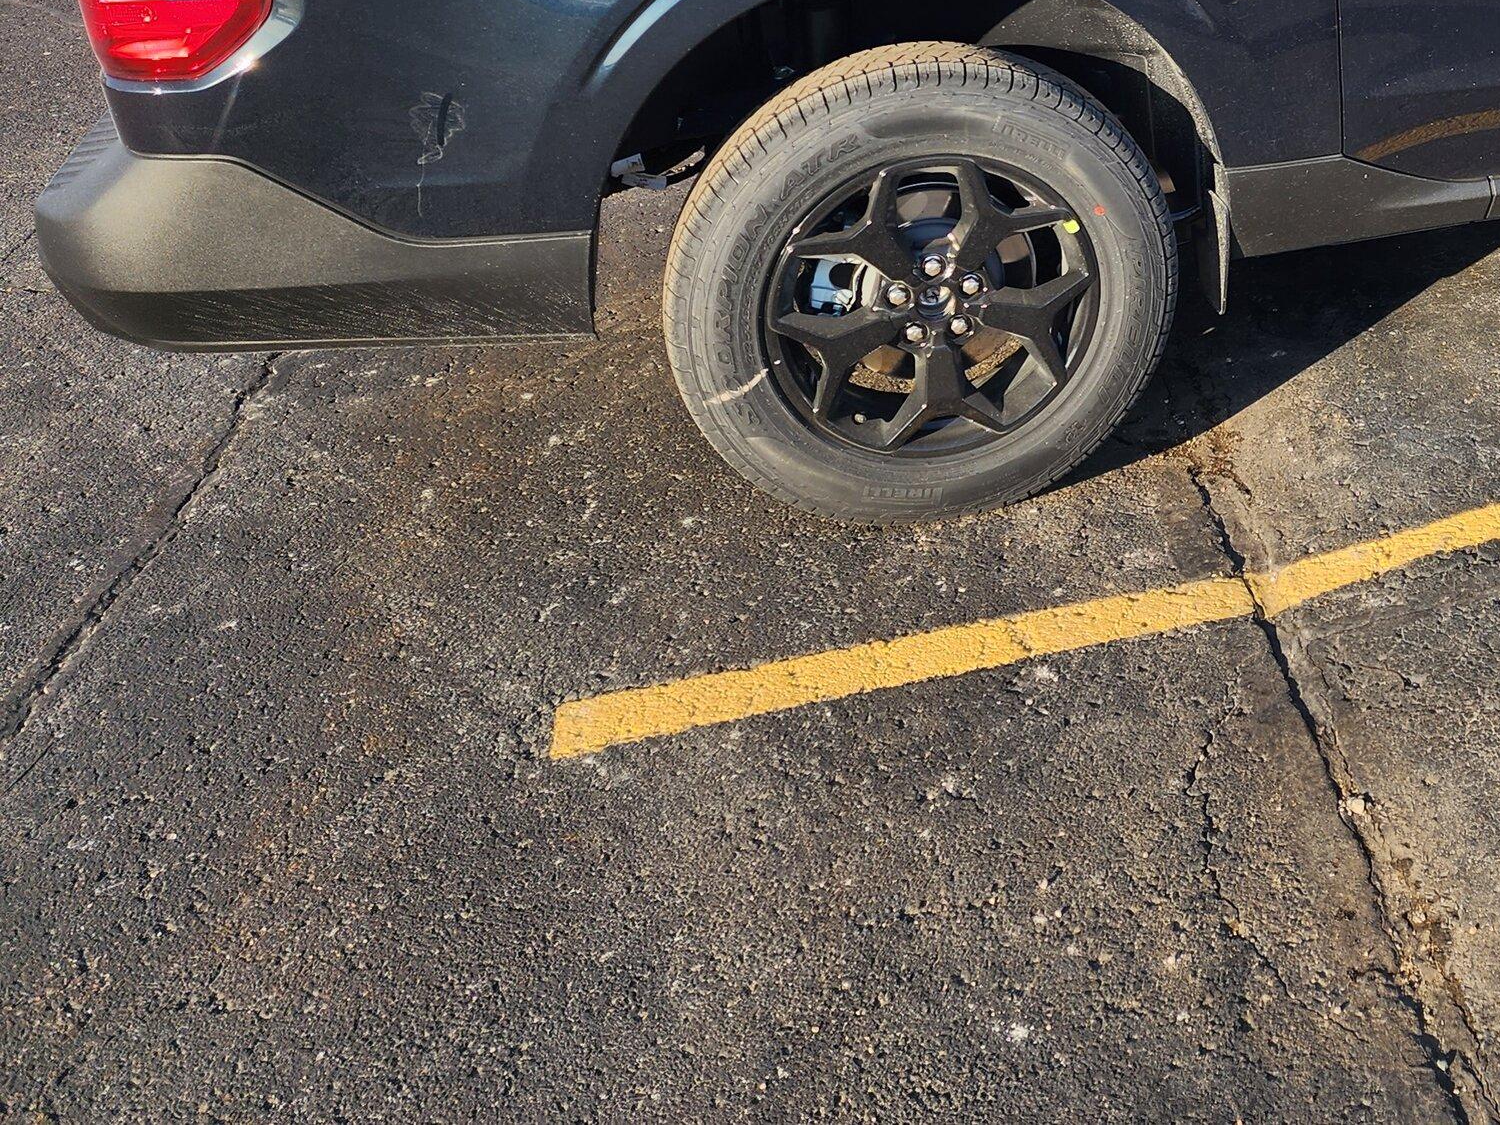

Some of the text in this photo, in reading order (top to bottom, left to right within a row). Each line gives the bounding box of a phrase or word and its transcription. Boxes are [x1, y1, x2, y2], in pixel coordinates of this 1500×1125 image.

[712, 132, 863, 427] SCORPION ATR
[1099, 247, 1149, 406] PIRELLI
